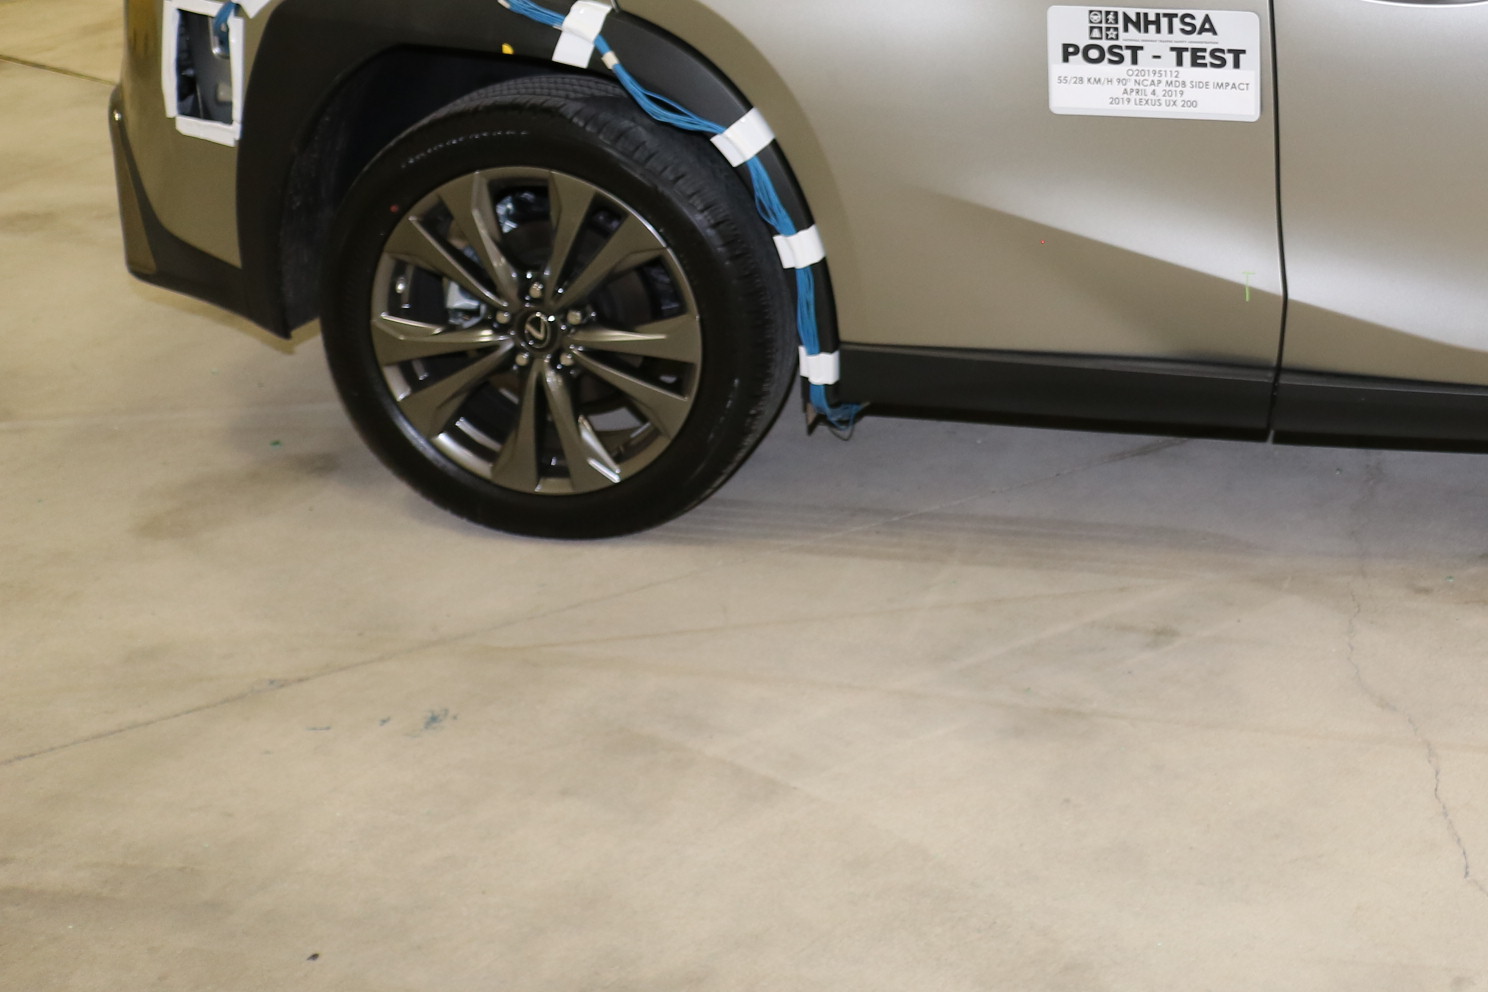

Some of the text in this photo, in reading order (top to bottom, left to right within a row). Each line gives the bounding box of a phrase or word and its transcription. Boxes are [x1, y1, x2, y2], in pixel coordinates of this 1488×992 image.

[1122, 11, 1218, 36] NHTSA
[1062, 43, 1144, 65] POST
[1169, 46, 1246, 69] TEST
[1057, 76, 1084, 85] 55/28
[1086, 77, 1113, 86] KM/H
[1133, 78, 1162, 88] NCAP
[1165, 80, 1187, 89] MDB
[1189, 81, 1210, 89] SIDE
[1212, 81, 1250, 91] IMPACT
[1122, 88, 1148, 97] APRIL
[1162, 89, 1184, 98] 2019
[1109, 96, 1198, 109] 2019 LEXUS UX 200
